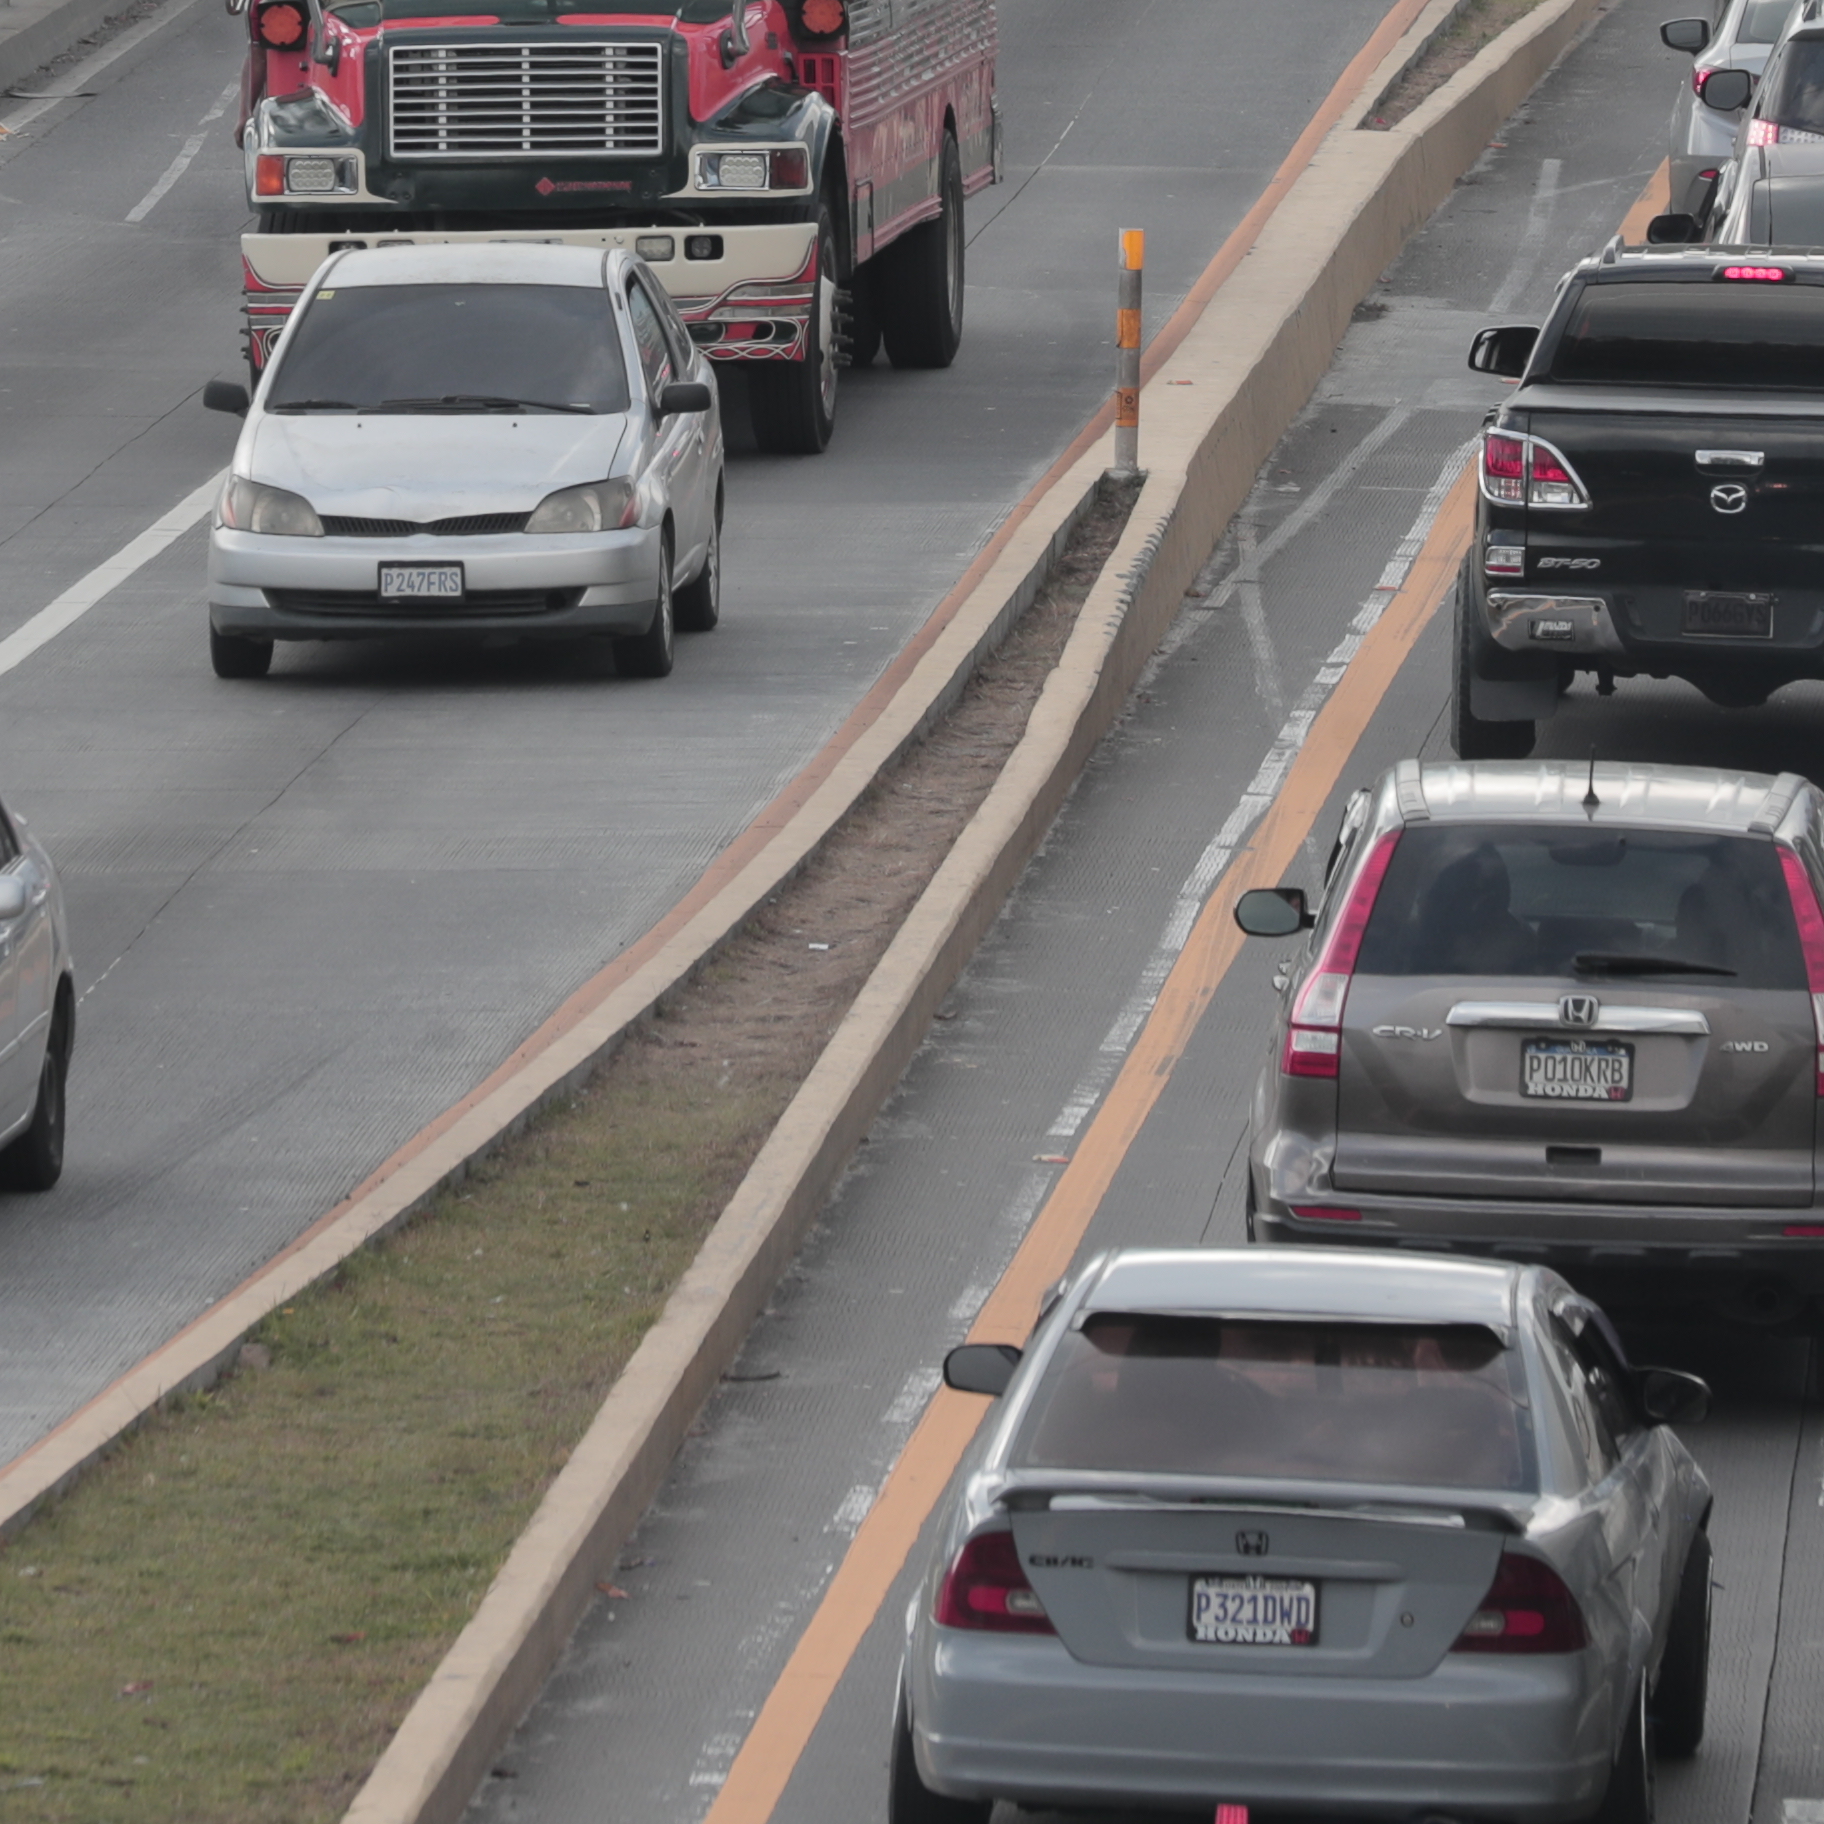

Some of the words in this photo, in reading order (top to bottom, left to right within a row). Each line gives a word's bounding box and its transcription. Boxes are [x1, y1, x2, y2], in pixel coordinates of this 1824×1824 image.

[1537, 557, 1601, 569] BT-50
[384, 571, 460, 593] P247FRS
[1719, 1040, 1769, 1053] 4WD
[1528, 1054, 1623, 1085] P010KRB
[1526, 1082, 1609, 1100] HONDA
[1195, 1592, 1311, 1629] P321DWD
[1195, 1623, 1292, 1645] HONDA
